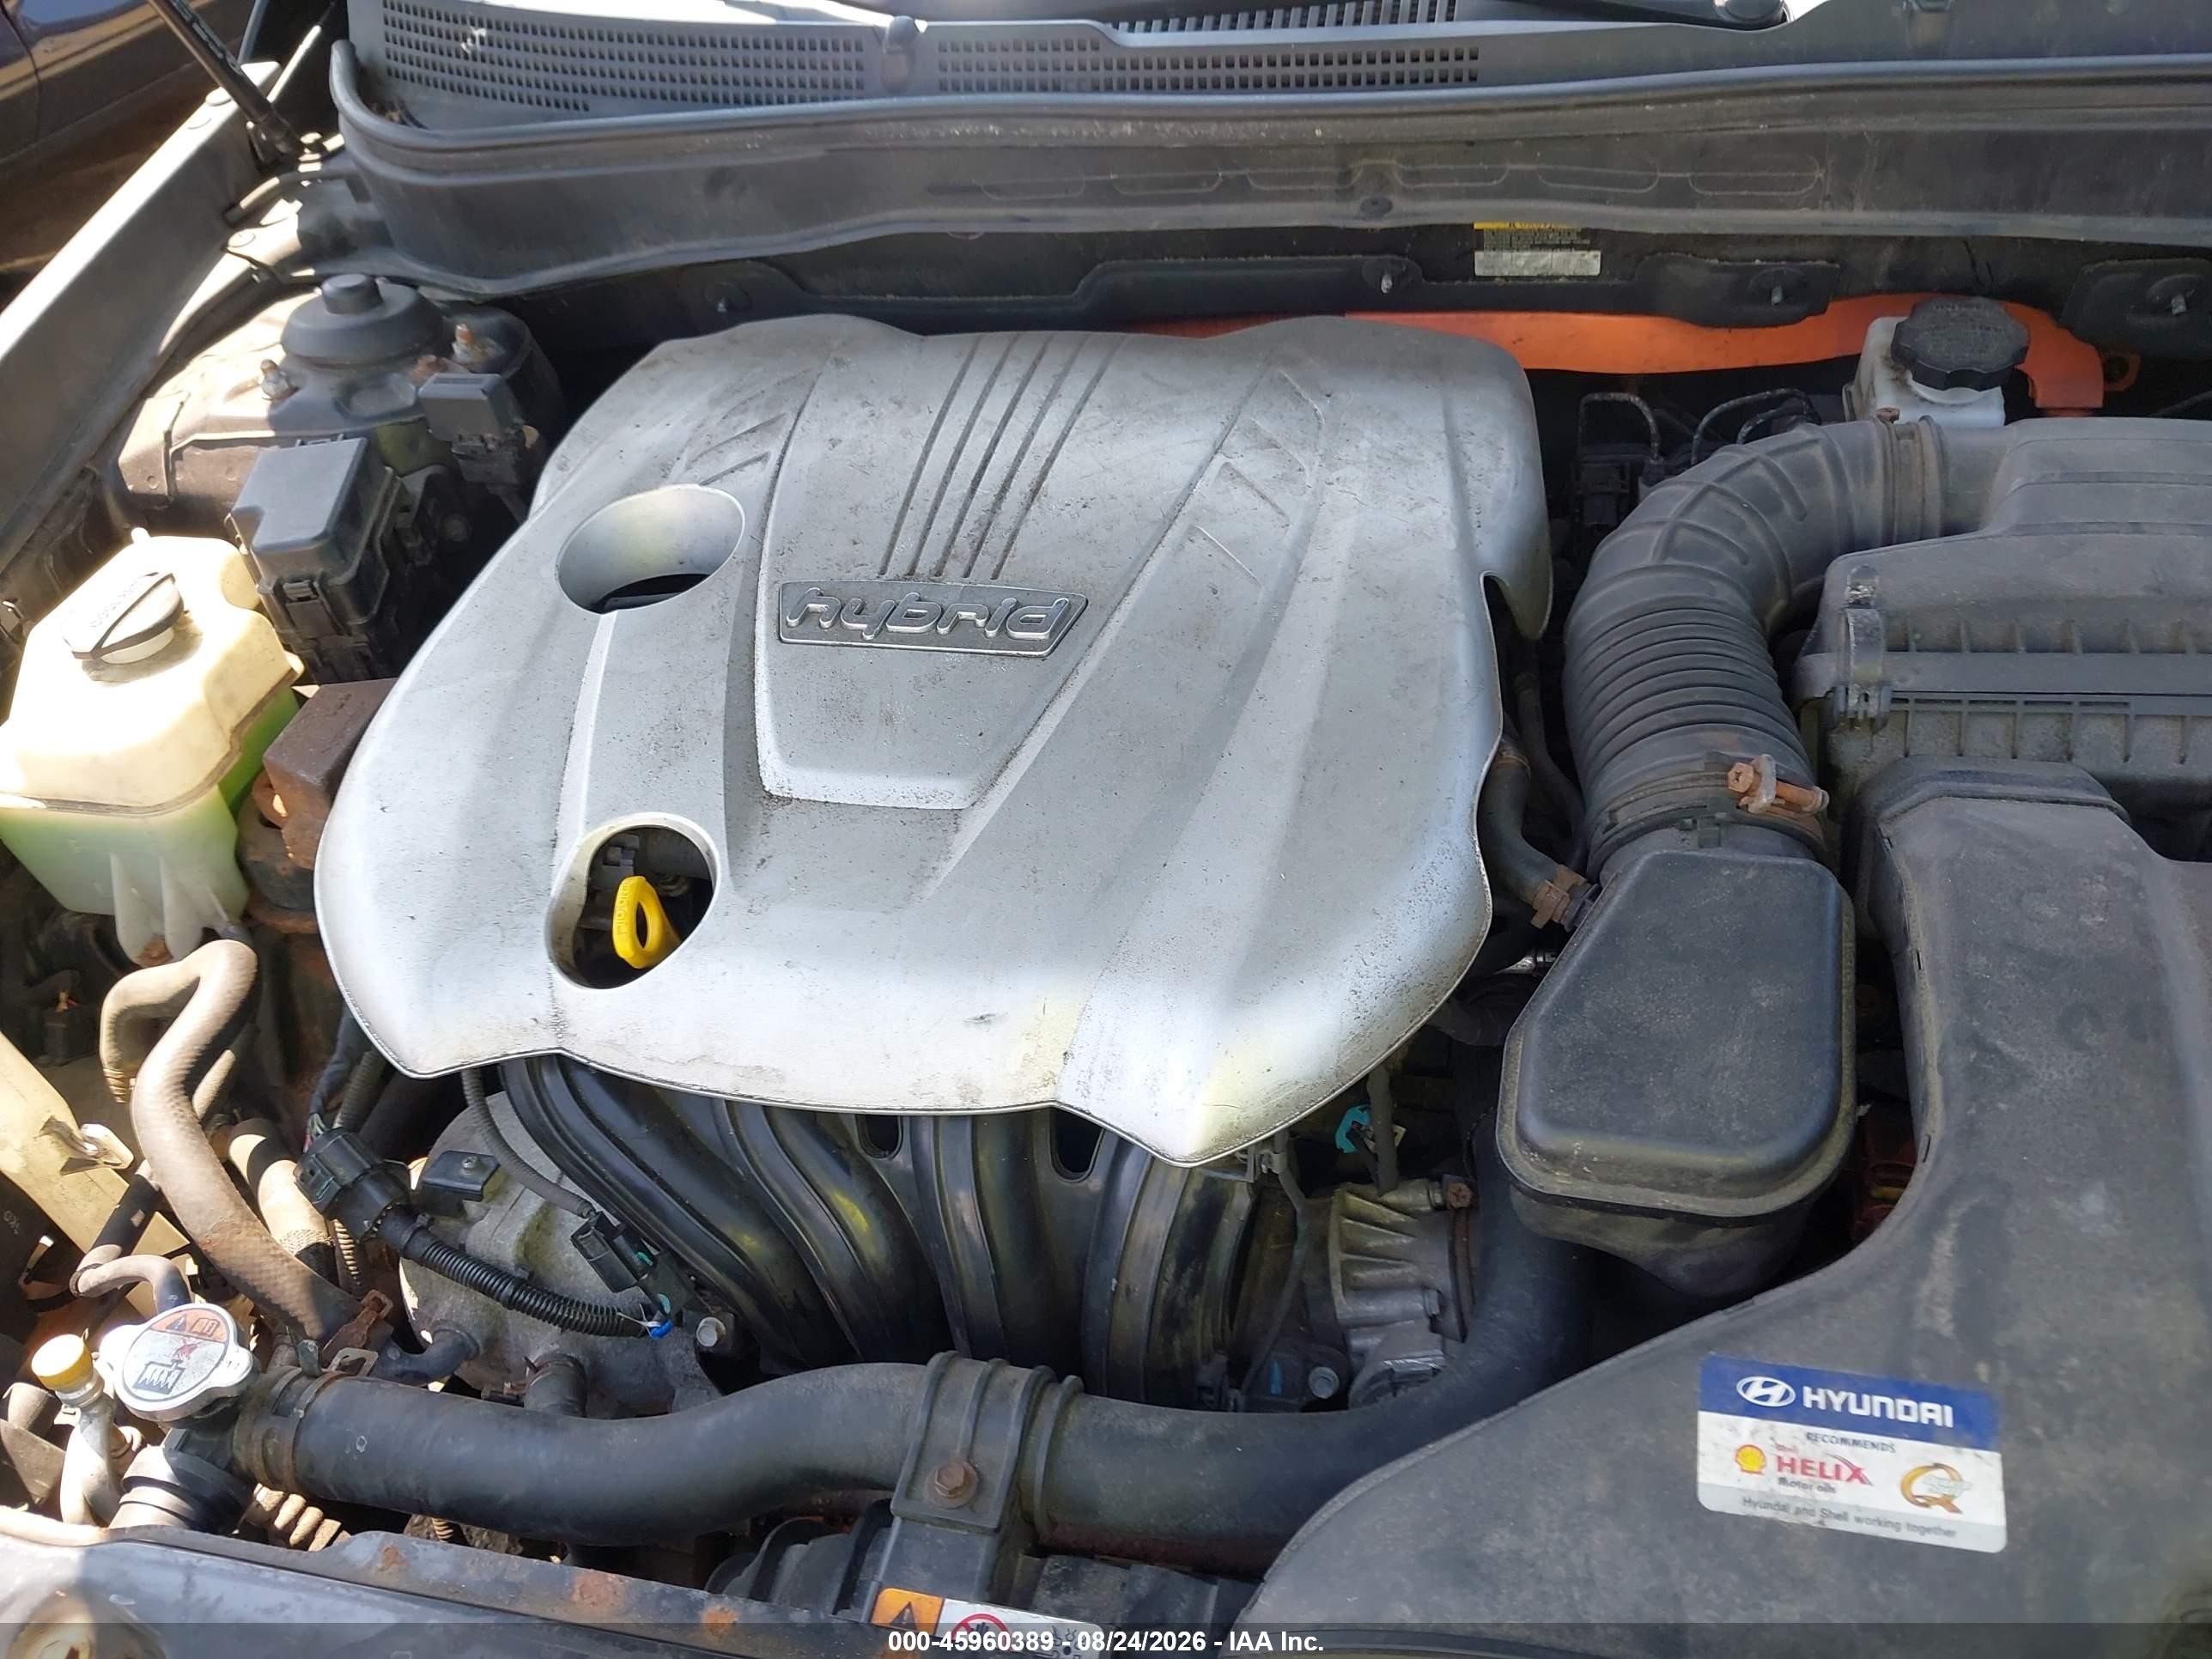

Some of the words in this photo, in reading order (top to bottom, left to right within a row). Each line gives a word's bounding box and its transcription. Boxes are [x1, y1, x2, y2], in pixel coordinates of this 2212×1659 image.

[786, 587, 1070, 641] hybrid
[1802, 1385, 1954, 1429] HYUNDAI
[1806, 1431, 1896, 1454] RECOMMENDS
[1776, 1455, 1870, 1486] HELIX
[1742, 1497, 1790, 1514] Hyundai
[1795, 1505, 1816, 1517] and
[1820, 1507, 1849, 1522] Shell
[1854, 1514, 1902, 1533] working
[1906, 1522, 1957, 1538] together
